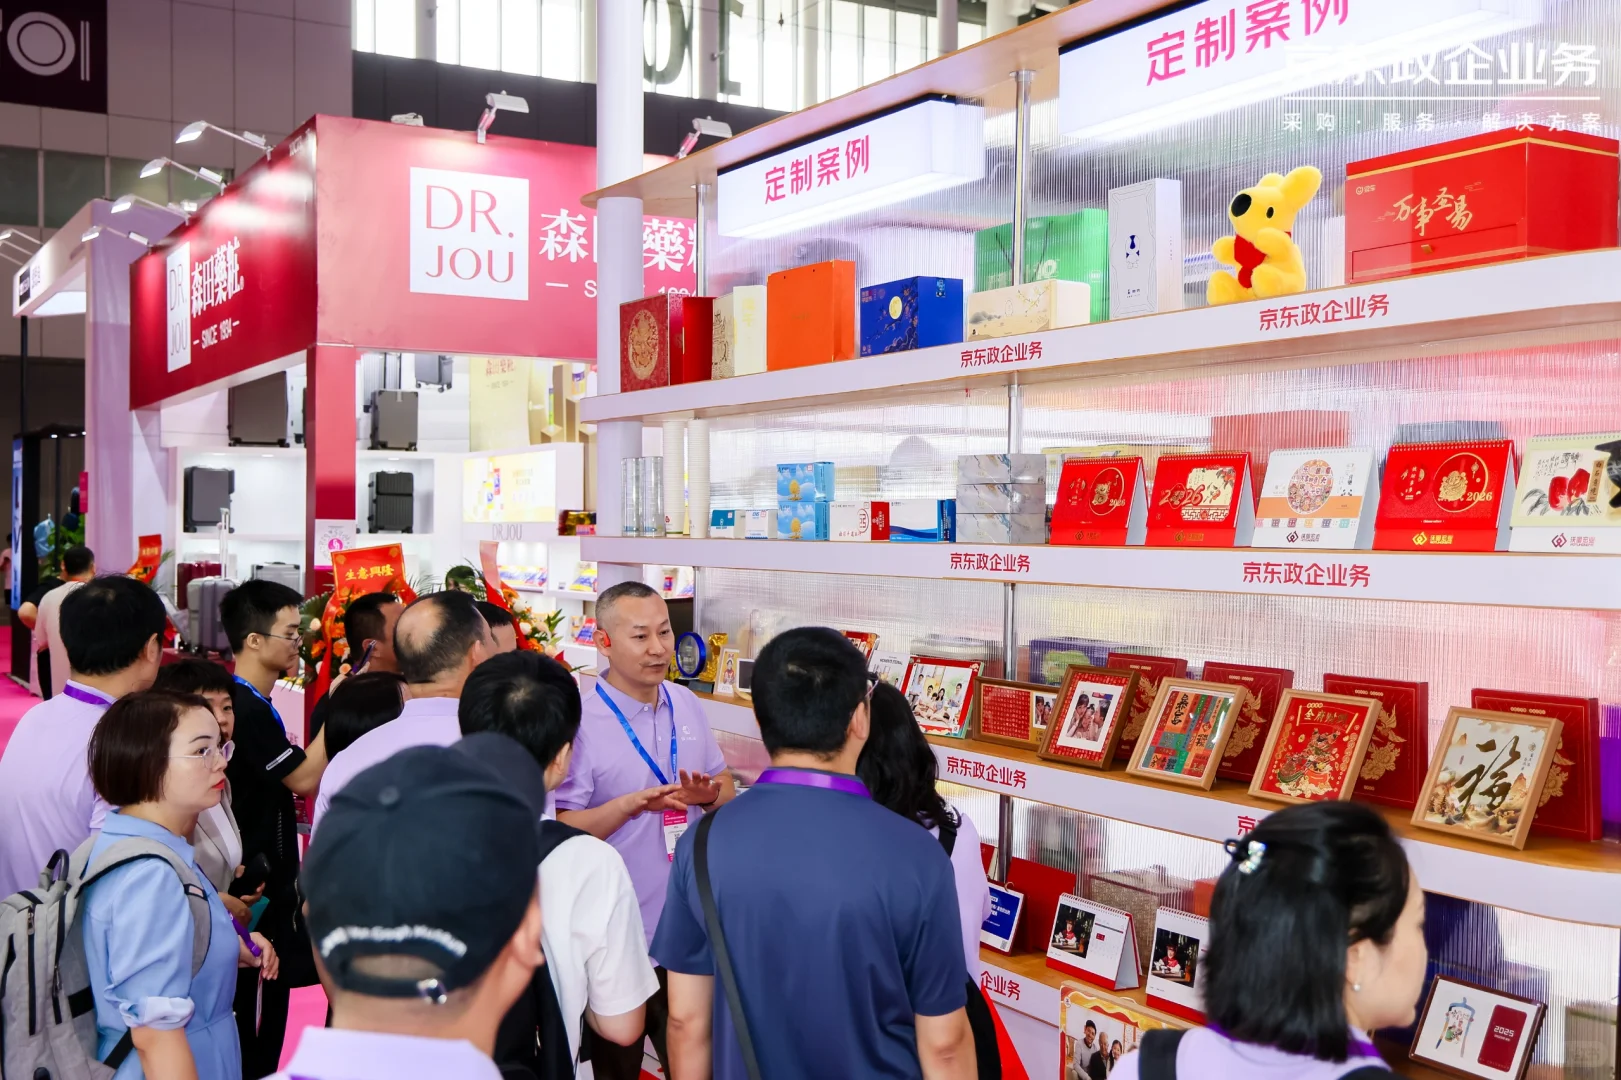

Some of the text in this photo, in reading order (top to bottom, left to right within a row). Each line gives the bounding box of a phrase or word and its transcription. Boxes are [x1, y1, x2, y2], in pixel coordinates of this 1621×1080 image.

[1146, 0, 1349, 86] 定制案例
[765, 135, 869, 205] 定制案例
[426, 185, 514, 239] DR.
[425, 245, 514, 283] JOU
[1259, 293, 1389, 331] 京东政企业务
[170, 314, 188, 356] JOU
[960, 341, 1043, 368] 京东政企业务
[1466, 492, 1493, 502] 2026
[950, 552, 1031, 573] 京东政企业务
[1242, 561, 1371, 588] 京东政企业务
[947, 756, 1027, 789] 京东政企业务
[1237, 815, 1262, 836] 京
[1494, 1025, 1515, 1037] 2025
